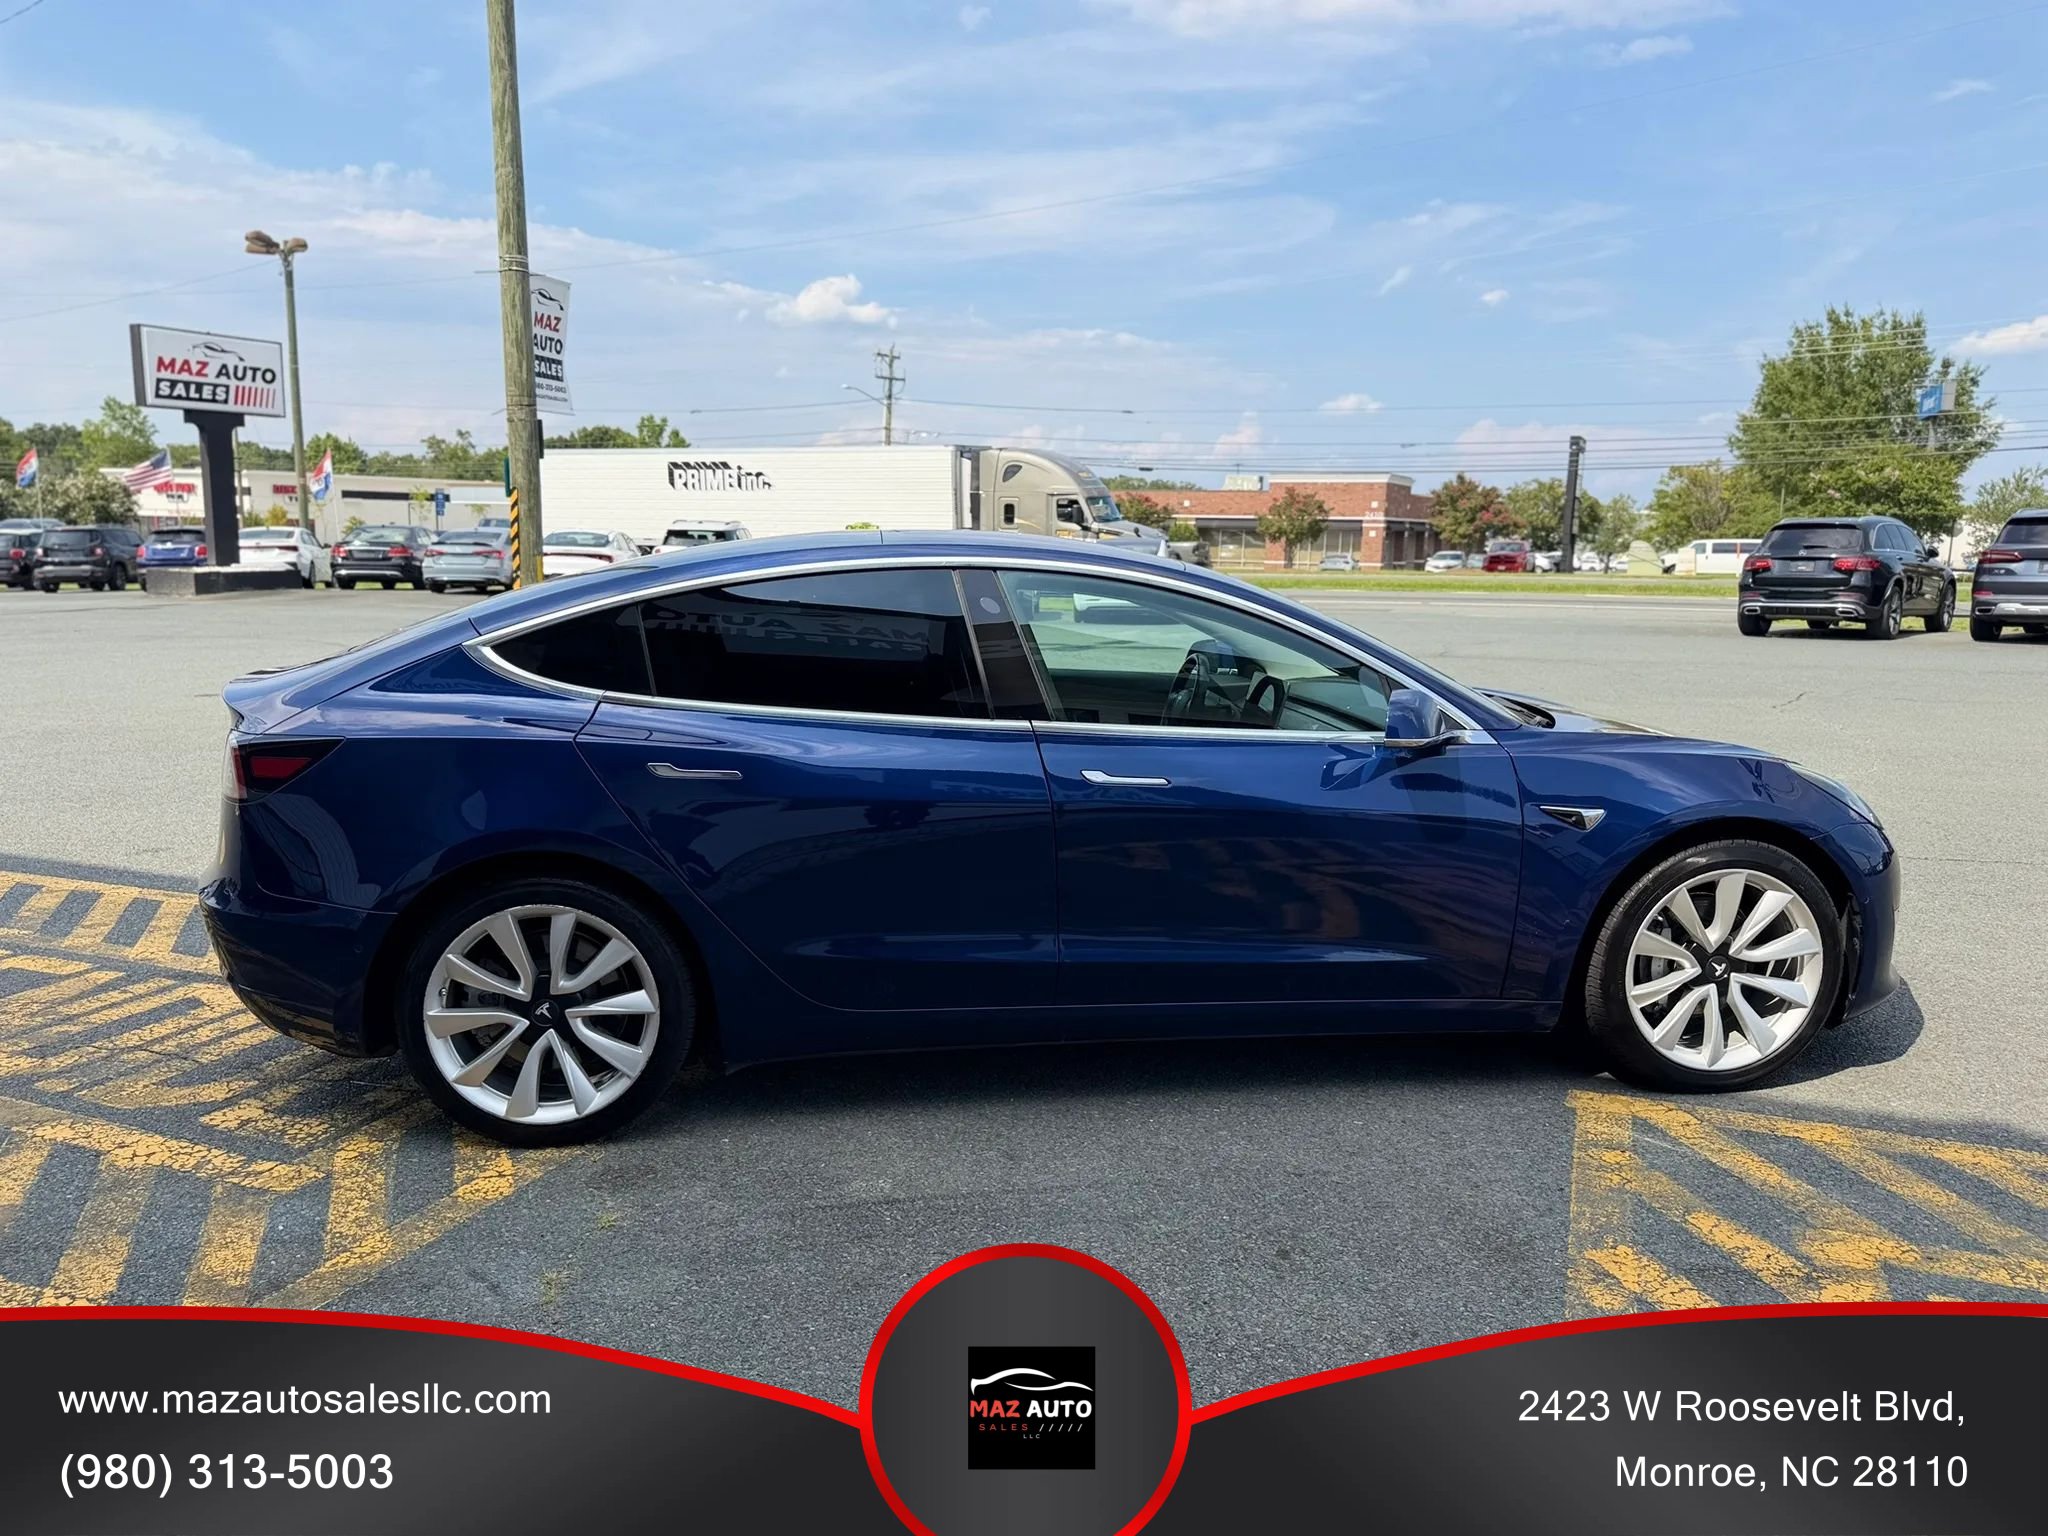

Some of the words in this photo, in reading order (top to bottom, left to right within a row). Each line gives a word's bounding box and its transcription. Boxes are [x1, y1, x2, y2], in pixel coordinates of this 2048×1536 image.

[534, 311, 562, 332] MAZ
[533, 333, 563, 354] AUTO
[156, 357, 208, 377] MAZ
[216, 364, 276, 384] AUTO
[534, 362, 562, 377] SALES
[158, 381, 227, 400] SALES
[668, 461, 737, 491] PRIME
